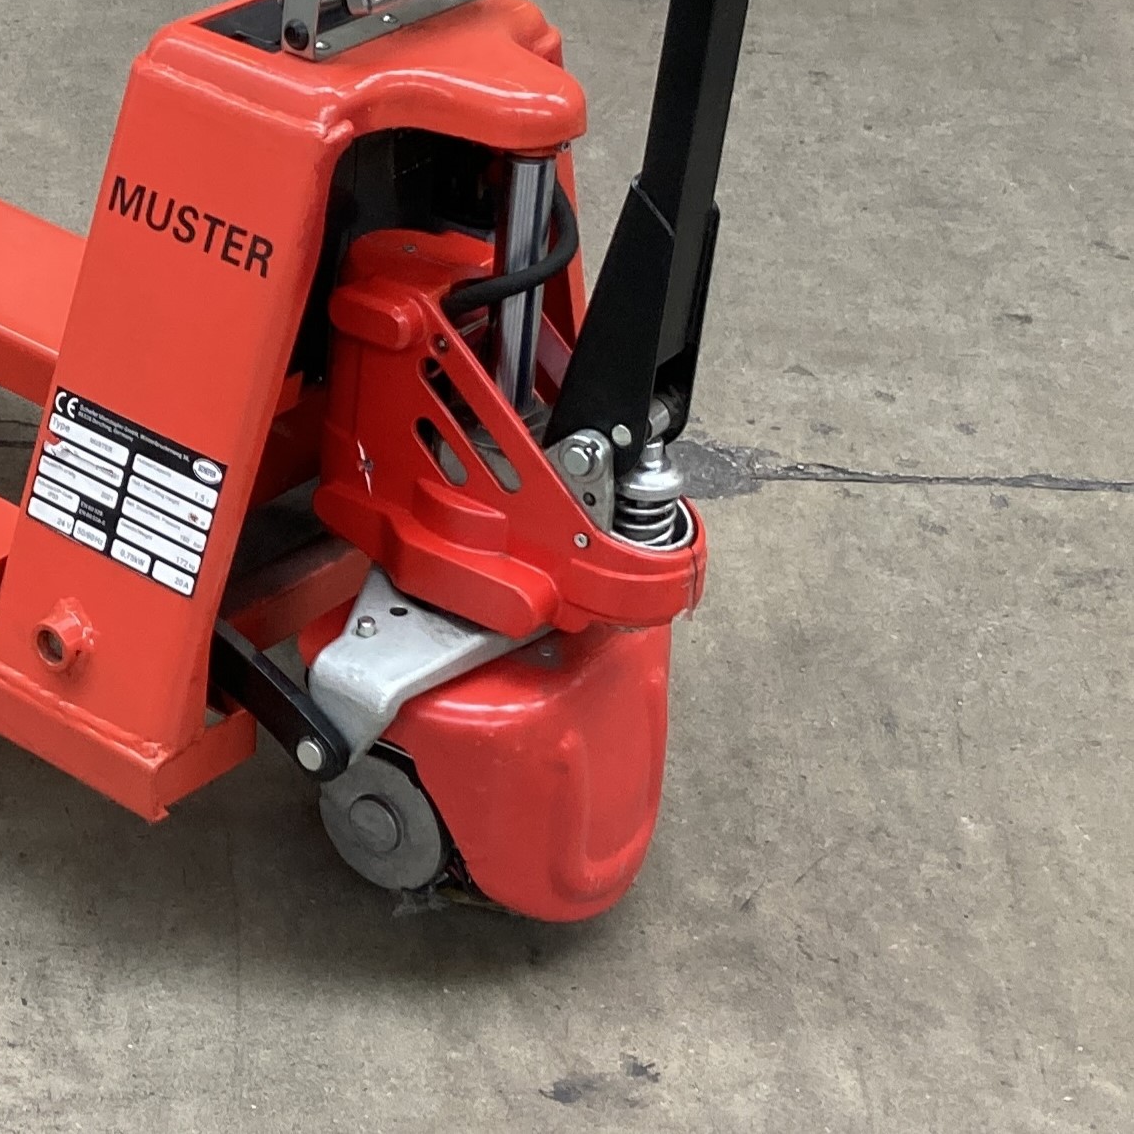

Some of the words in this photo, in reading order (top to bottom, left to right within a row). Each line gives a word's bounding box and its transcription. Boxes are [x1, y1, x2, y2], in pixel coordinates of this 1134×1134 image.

[108, 175, 274, 279] MUSTER
[52, 416, 71, 434] Type
[56, 516, 65, 527] 24
[174, 576, 183, 586] 20
